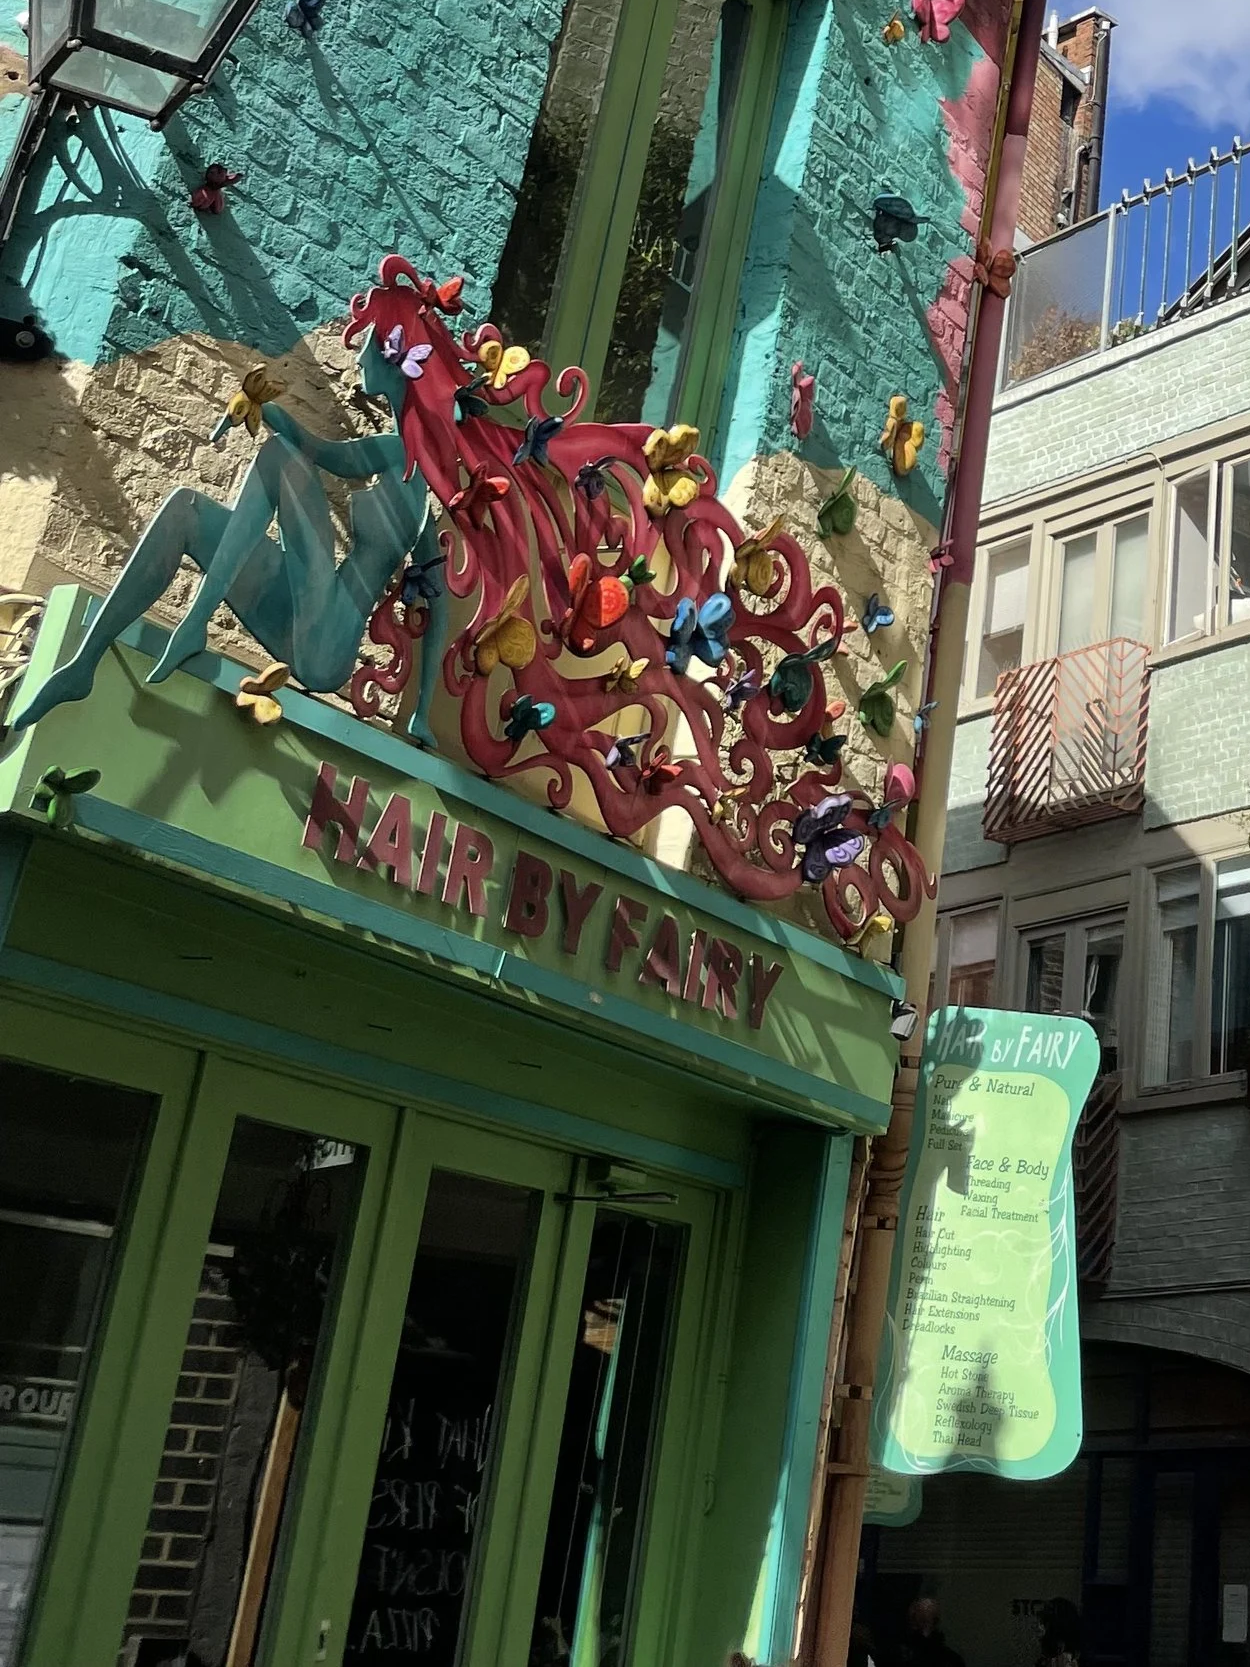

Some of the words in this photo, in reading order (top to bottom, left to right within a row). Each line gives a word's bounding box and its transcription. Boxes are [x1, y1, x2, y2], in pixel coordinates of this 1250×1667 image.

[302, 760, 494, 917] HAIR
[502, 850, 604, 954] BY
[607, 894, 784, 1029] FAIRY
[936, 1020, 987, 1061] HAIR
[990, 1038, 1014, 1063] BY
[1013, 1025, 1082, 1070] FAIRY
[934, 1074, 964, 1090] Pure
[969, 1076, 981, 1091] &
[986, 1078, 1035, 1097] Natural
[932, 1109, 975, 1123] Manicure
[930, 1124, 969, 1137] Pedicure
[928, 1138, 945, 1150] Full
[947, 1140, 963, 1152] Set
[967, 1155, 995, 1171] Face
[999, 1157, 1012, 1173] &
[1016, 1159, 1049, 1181] Body
[967, 1175, 1012, 1192] Threading
[963, 1190, 998, 1207] Waxing
[916, 1205, 945, 1222] Hair
[960, 1205, 988, 1219] Facial
[991, 1207, 1039, 1223] Treatment
[915, 1225, 935, 1238] Hair
[938, 1228, 955, 1241] Cut
[912, 1241, 972, 1261] Highlighting
[911, 1256, 947, 1271] Colours
[909, 1272, 933, 1285] Perm
[906, 1288, 948, 1303] Brazilian
[951, 1292, 1016, 1311] Straightening
[904, 1303, 924, 1316] Hair
[928, 1306, 980, 1321] Extensions
[902, 1319, 956, 1335] Dreadlocks
[941, 1345, 998, 1369] Massage
[941, 1366, 958, 1380] Hot
[962, 1369, 990, 1383] Stone
[938, 1383, 971, 1396] Aroma
[975, 1386, 1015, 1404] Therapy
[936, 1399, 976, 1414] Swedish
[980, 1403, 1005, 1421] Deep
[1009, 1405, 1040, 1419] Tissue
[934, 1415, 993, 1435] Reflexology
[933, 1431, 953, 1444] Thai
[957, 1434, 982, 1447] Head
